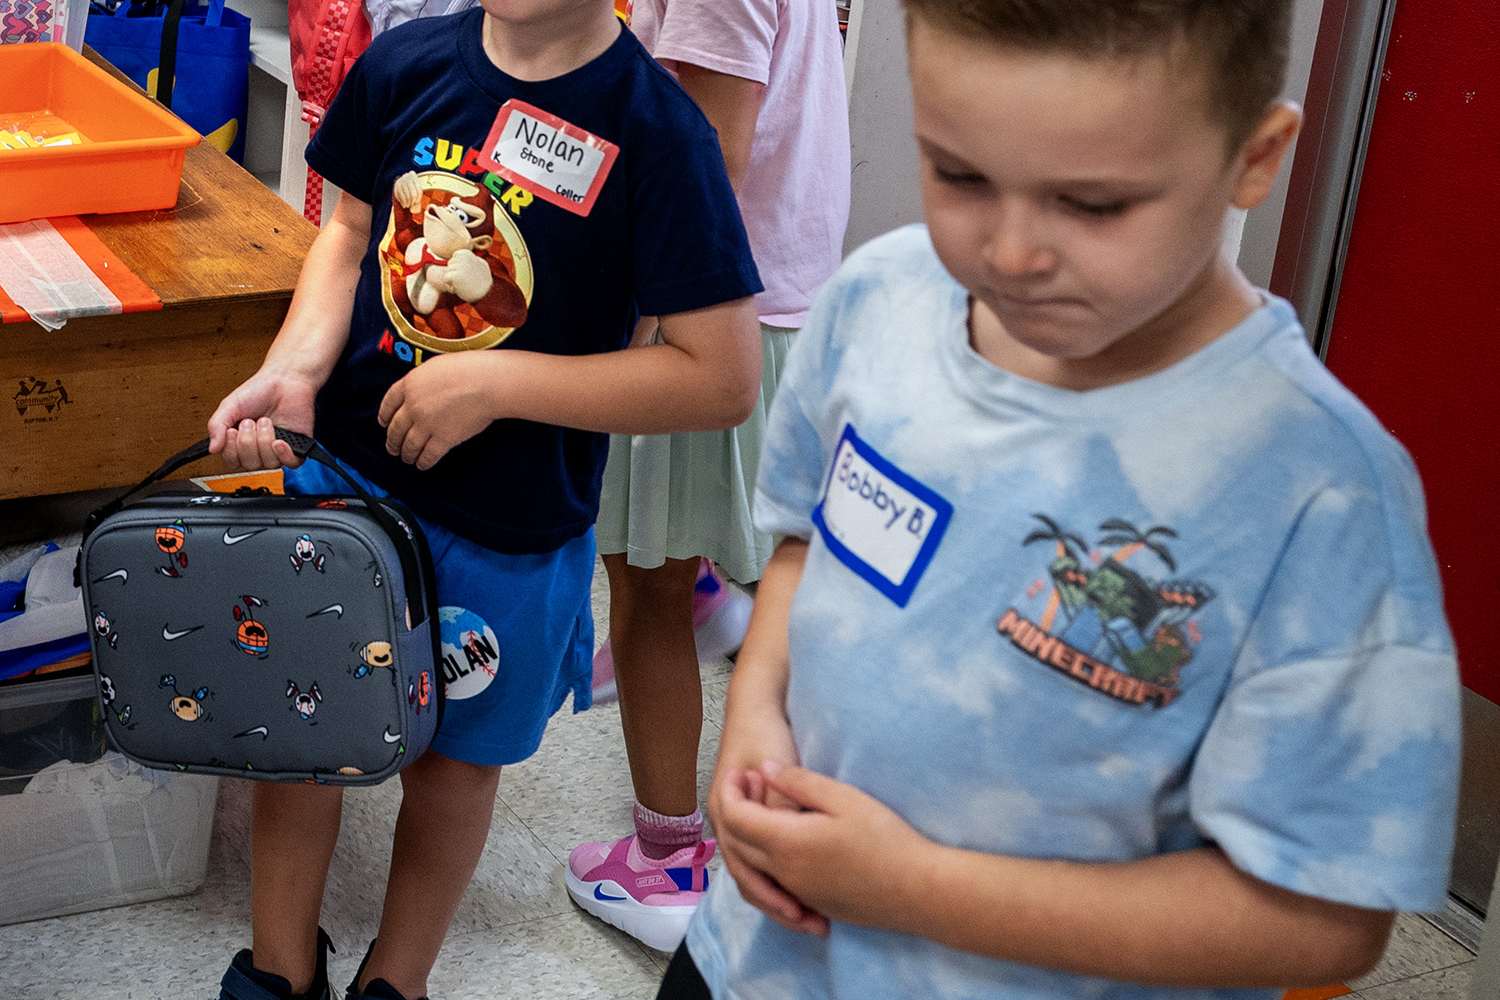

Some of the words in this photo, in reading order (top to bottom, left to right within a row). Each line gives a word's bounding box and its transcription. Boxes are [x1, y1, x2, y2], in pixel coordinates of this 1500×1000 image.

[493, 151, 501, 163] K
[515, 118, 584, 166] Nolan
[520, 147, 554, 173] Stone
[412, 136, 534, 216] SUPER
[838, 451, 906, 531] Bobby
[997, 607, 1180, 709] MINECRAFT
